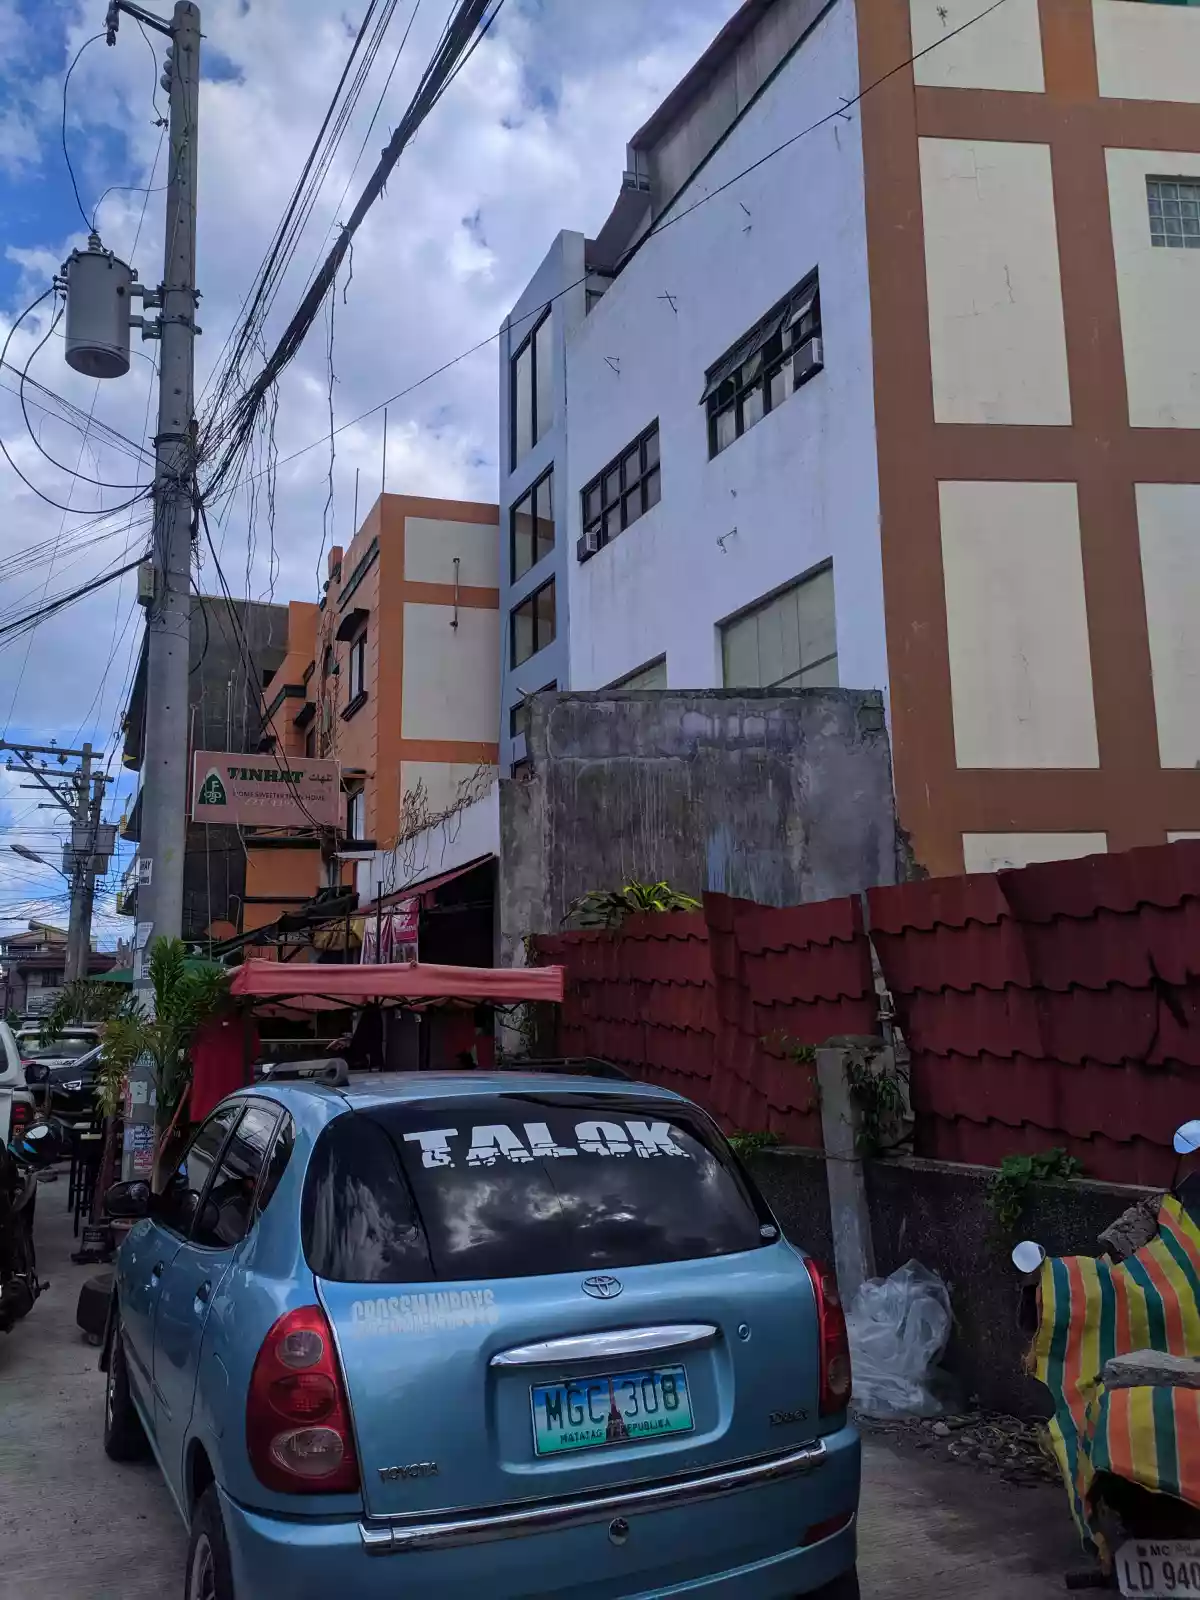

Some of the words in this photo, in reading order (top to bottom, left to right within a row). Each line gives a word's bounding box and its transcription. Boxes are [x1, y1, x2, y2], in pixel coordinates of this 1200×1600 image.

[403, 1120, 691, 1168] TALOK
[545, 1384, 605, 1431] MGC
[620, 1374, 680, 1417] 308
[1124, 1559, 1153, 1592] LD
